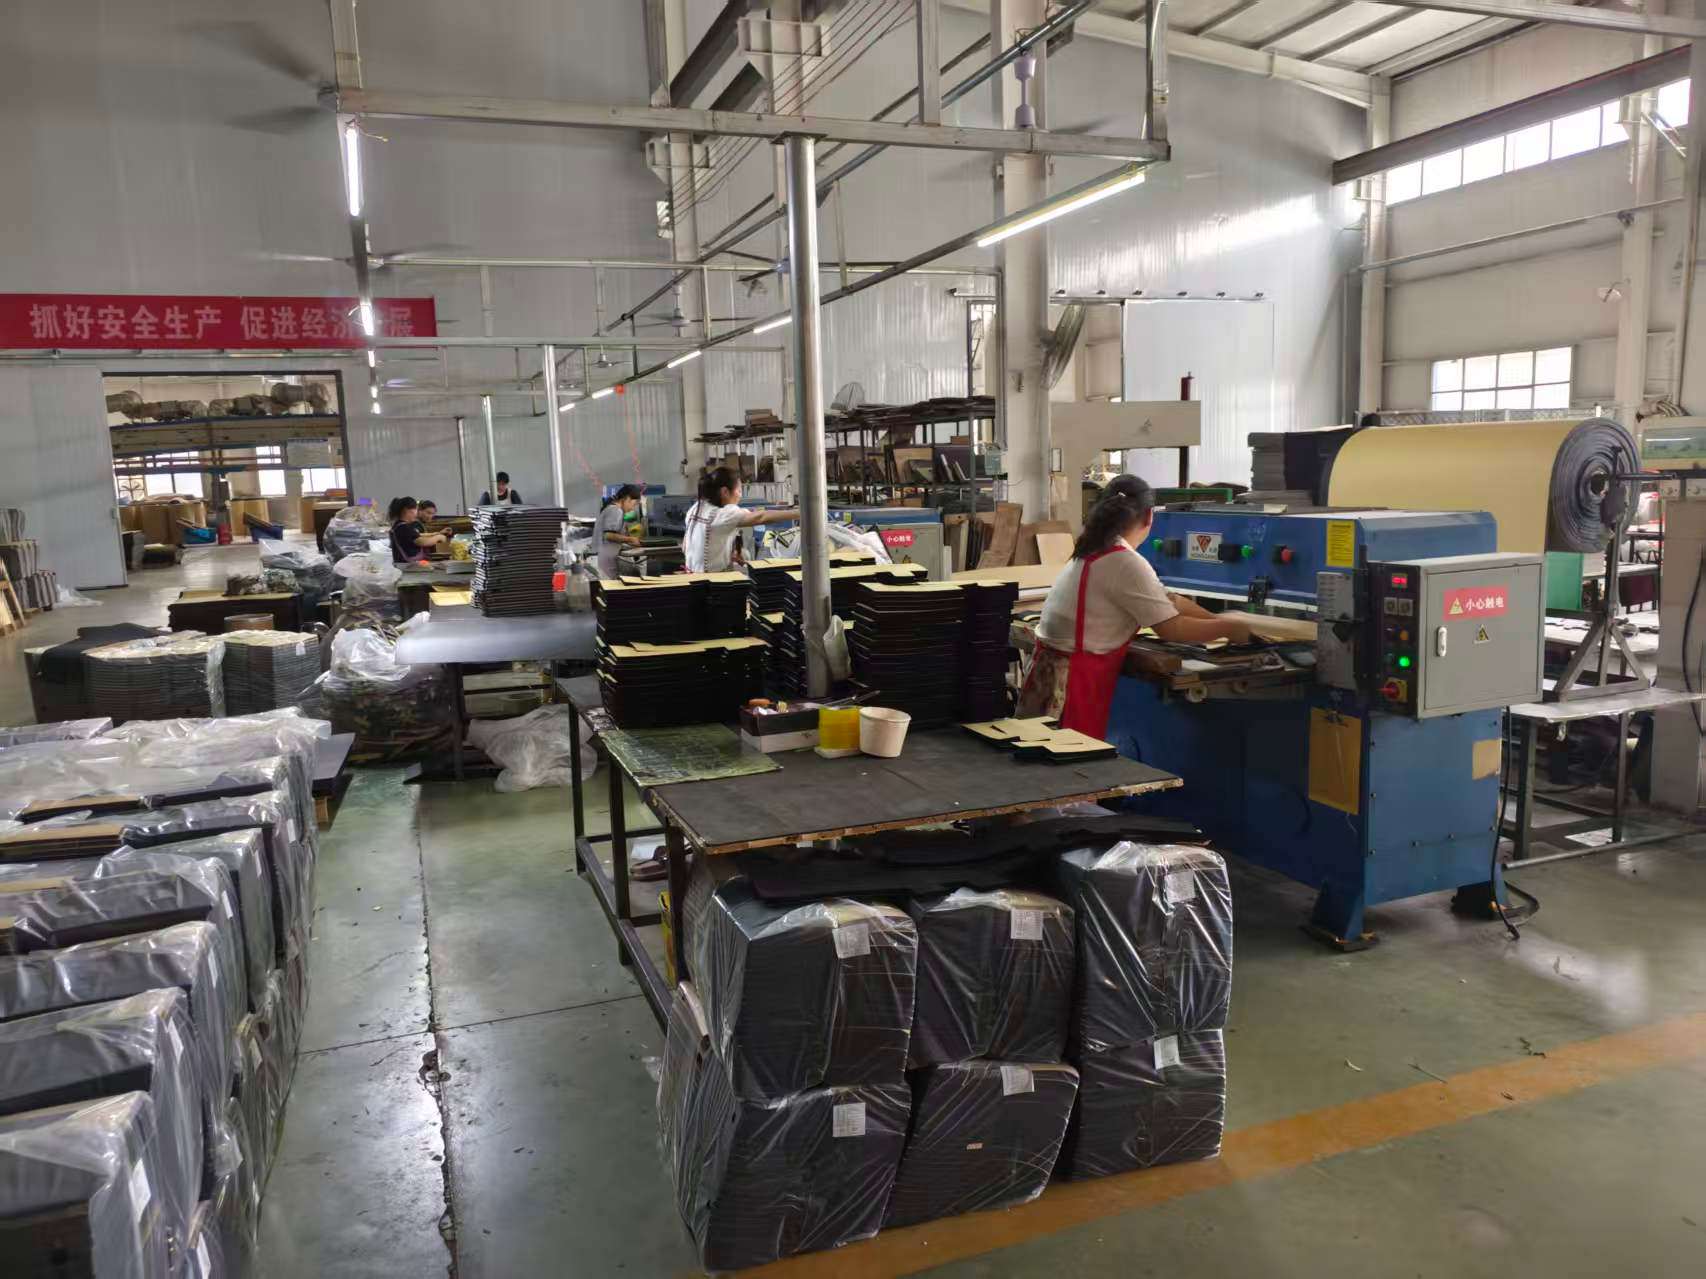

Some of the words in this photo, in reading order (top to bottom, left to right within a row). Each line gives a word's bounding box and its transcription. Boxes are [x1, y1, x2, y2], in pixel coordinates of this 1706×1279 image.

[29, 303, 222, 340] 抓好安全生产
[240, 305, 415, 338] 促进经济展
[1465, 595, 1504, 611] 小心触电
